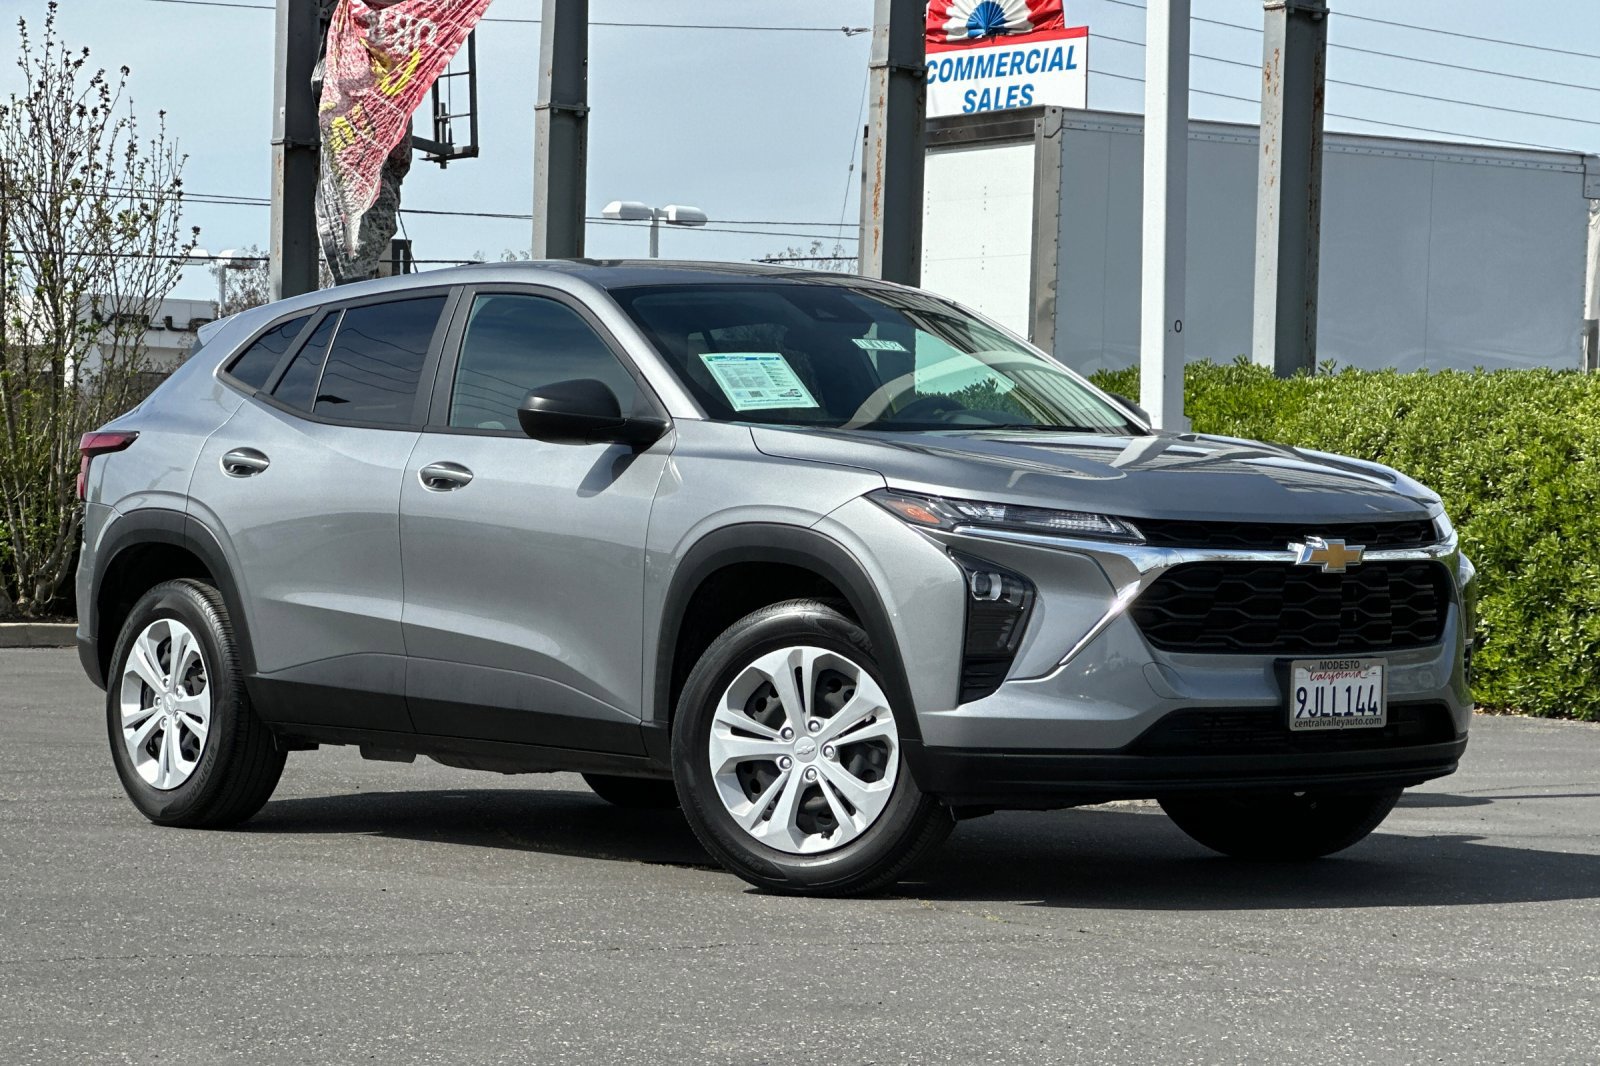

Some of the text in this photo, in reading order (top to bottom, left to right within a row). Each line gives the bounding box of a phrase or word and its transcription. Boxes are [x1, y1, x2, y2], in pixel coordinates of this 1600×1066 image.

[926, 45, 1078, 84] COMMERCIAL
[962, 83, 1034, 113] SALES
[1319, 660, 1360, 670] MODESTO
[1310, 671, 1368, 685] California
[1296, 685, 1378, 718] 9JLL144
[1294, 717, 1382, 728] centralvalleyauto.com
